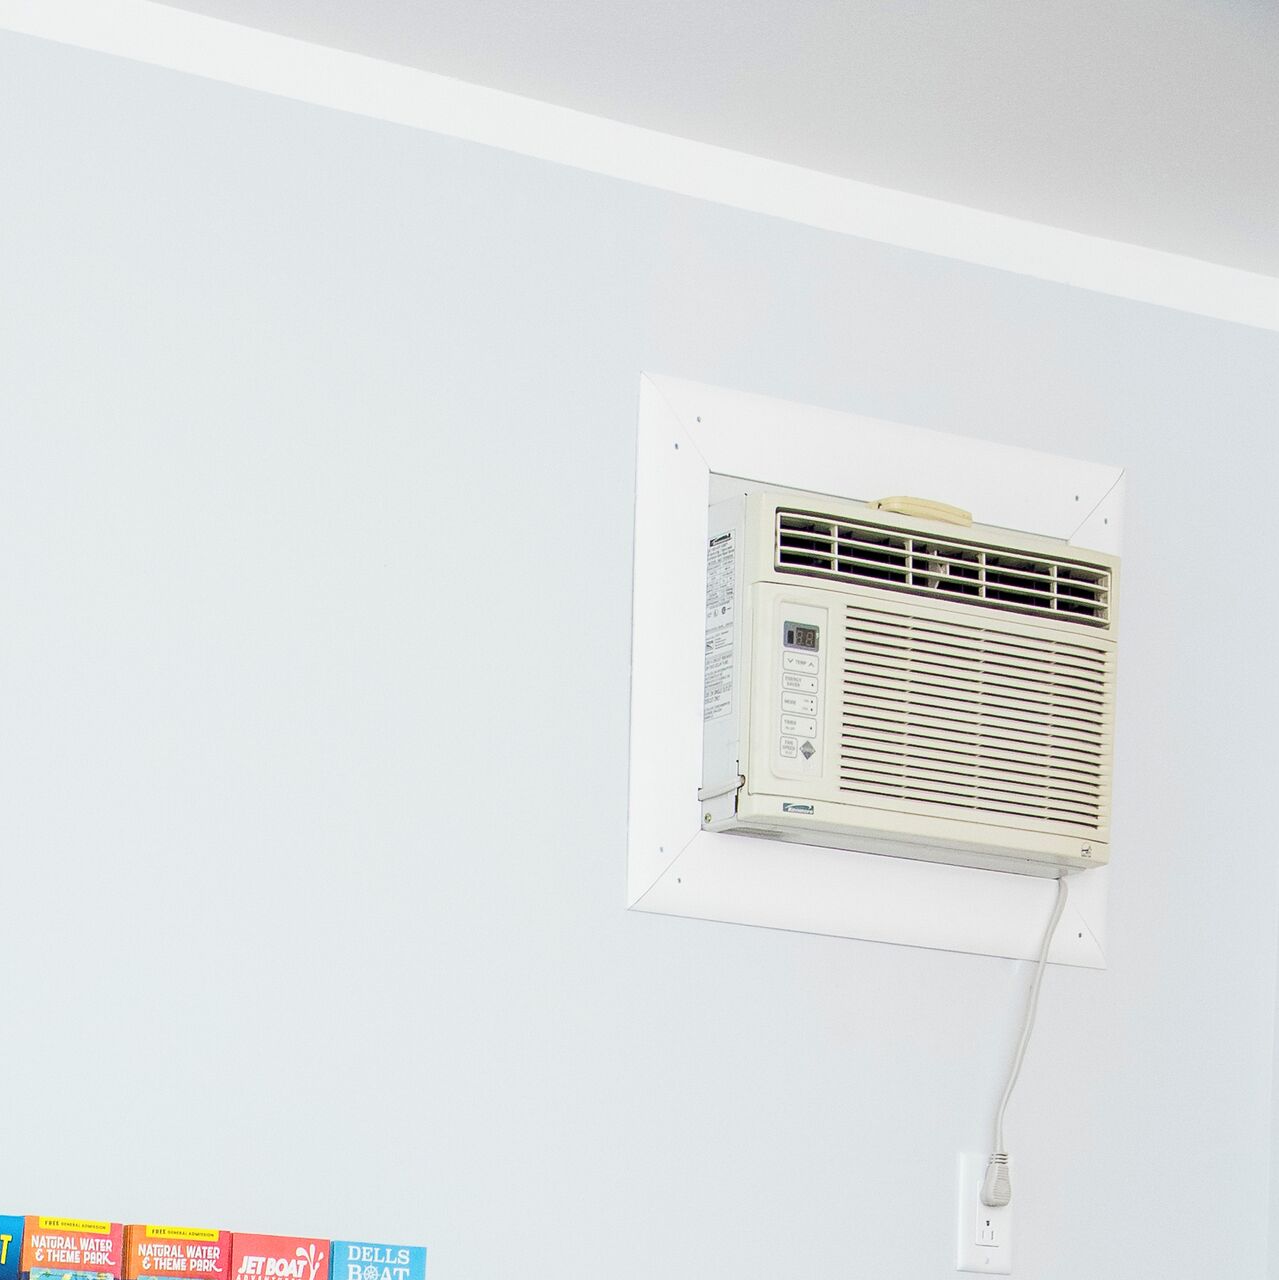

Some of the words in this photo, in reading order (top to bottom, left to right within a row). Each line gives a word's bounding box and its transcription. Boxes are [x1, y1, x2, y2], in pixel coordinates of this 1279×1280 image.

[31, 1235, 78, 1252] NATURAL
[80, 1238, 113, 1252] WATER
[47, 1250, 81, 1264] THEME
[82, 1250, 116, 1266] PARK
[348, 1245, 410, 1265] DELLS
